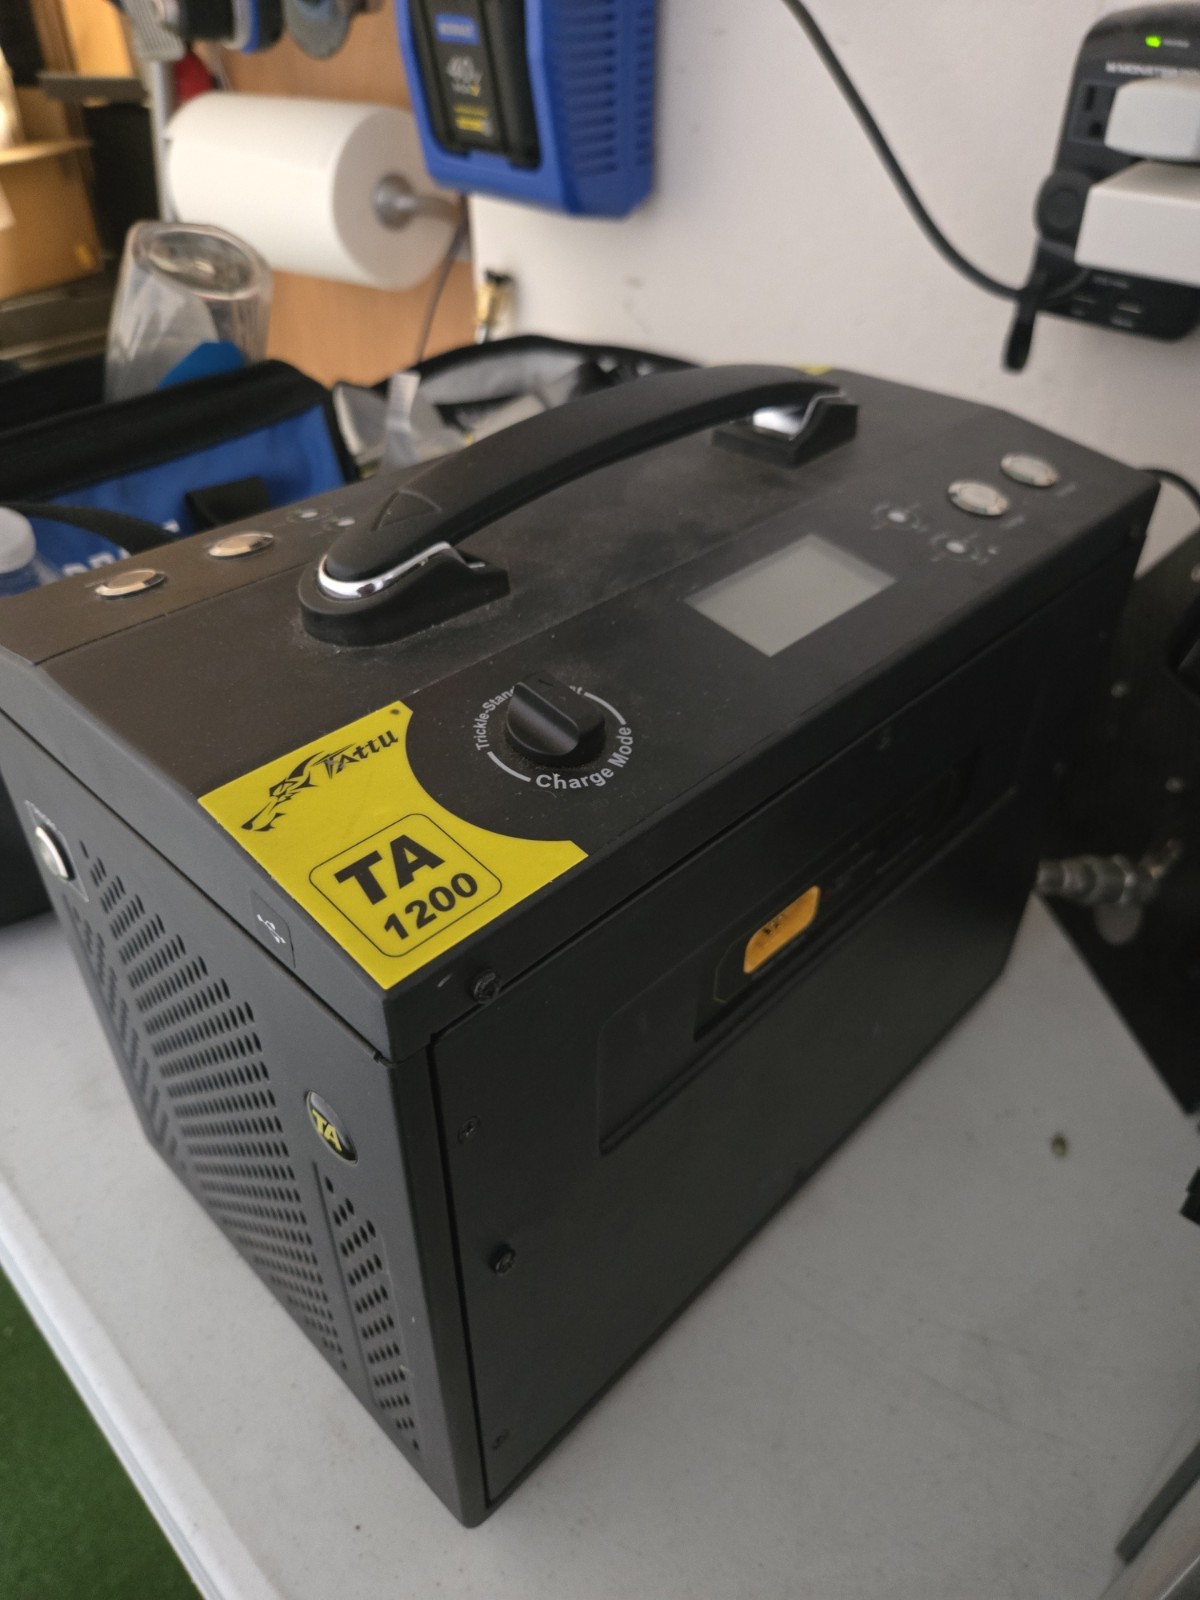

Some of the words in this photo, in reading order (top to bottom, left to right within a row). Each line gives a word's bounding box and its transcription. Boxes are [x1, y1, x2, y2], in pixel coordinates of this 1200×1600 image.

[536, 766, 614, 789] Charge
[607, 727, 633, 768] Mode
[333, 834, 446, 905] TA
[383, 872, 478, 940] 1200
[312, 1108, 343, 1152] TA
